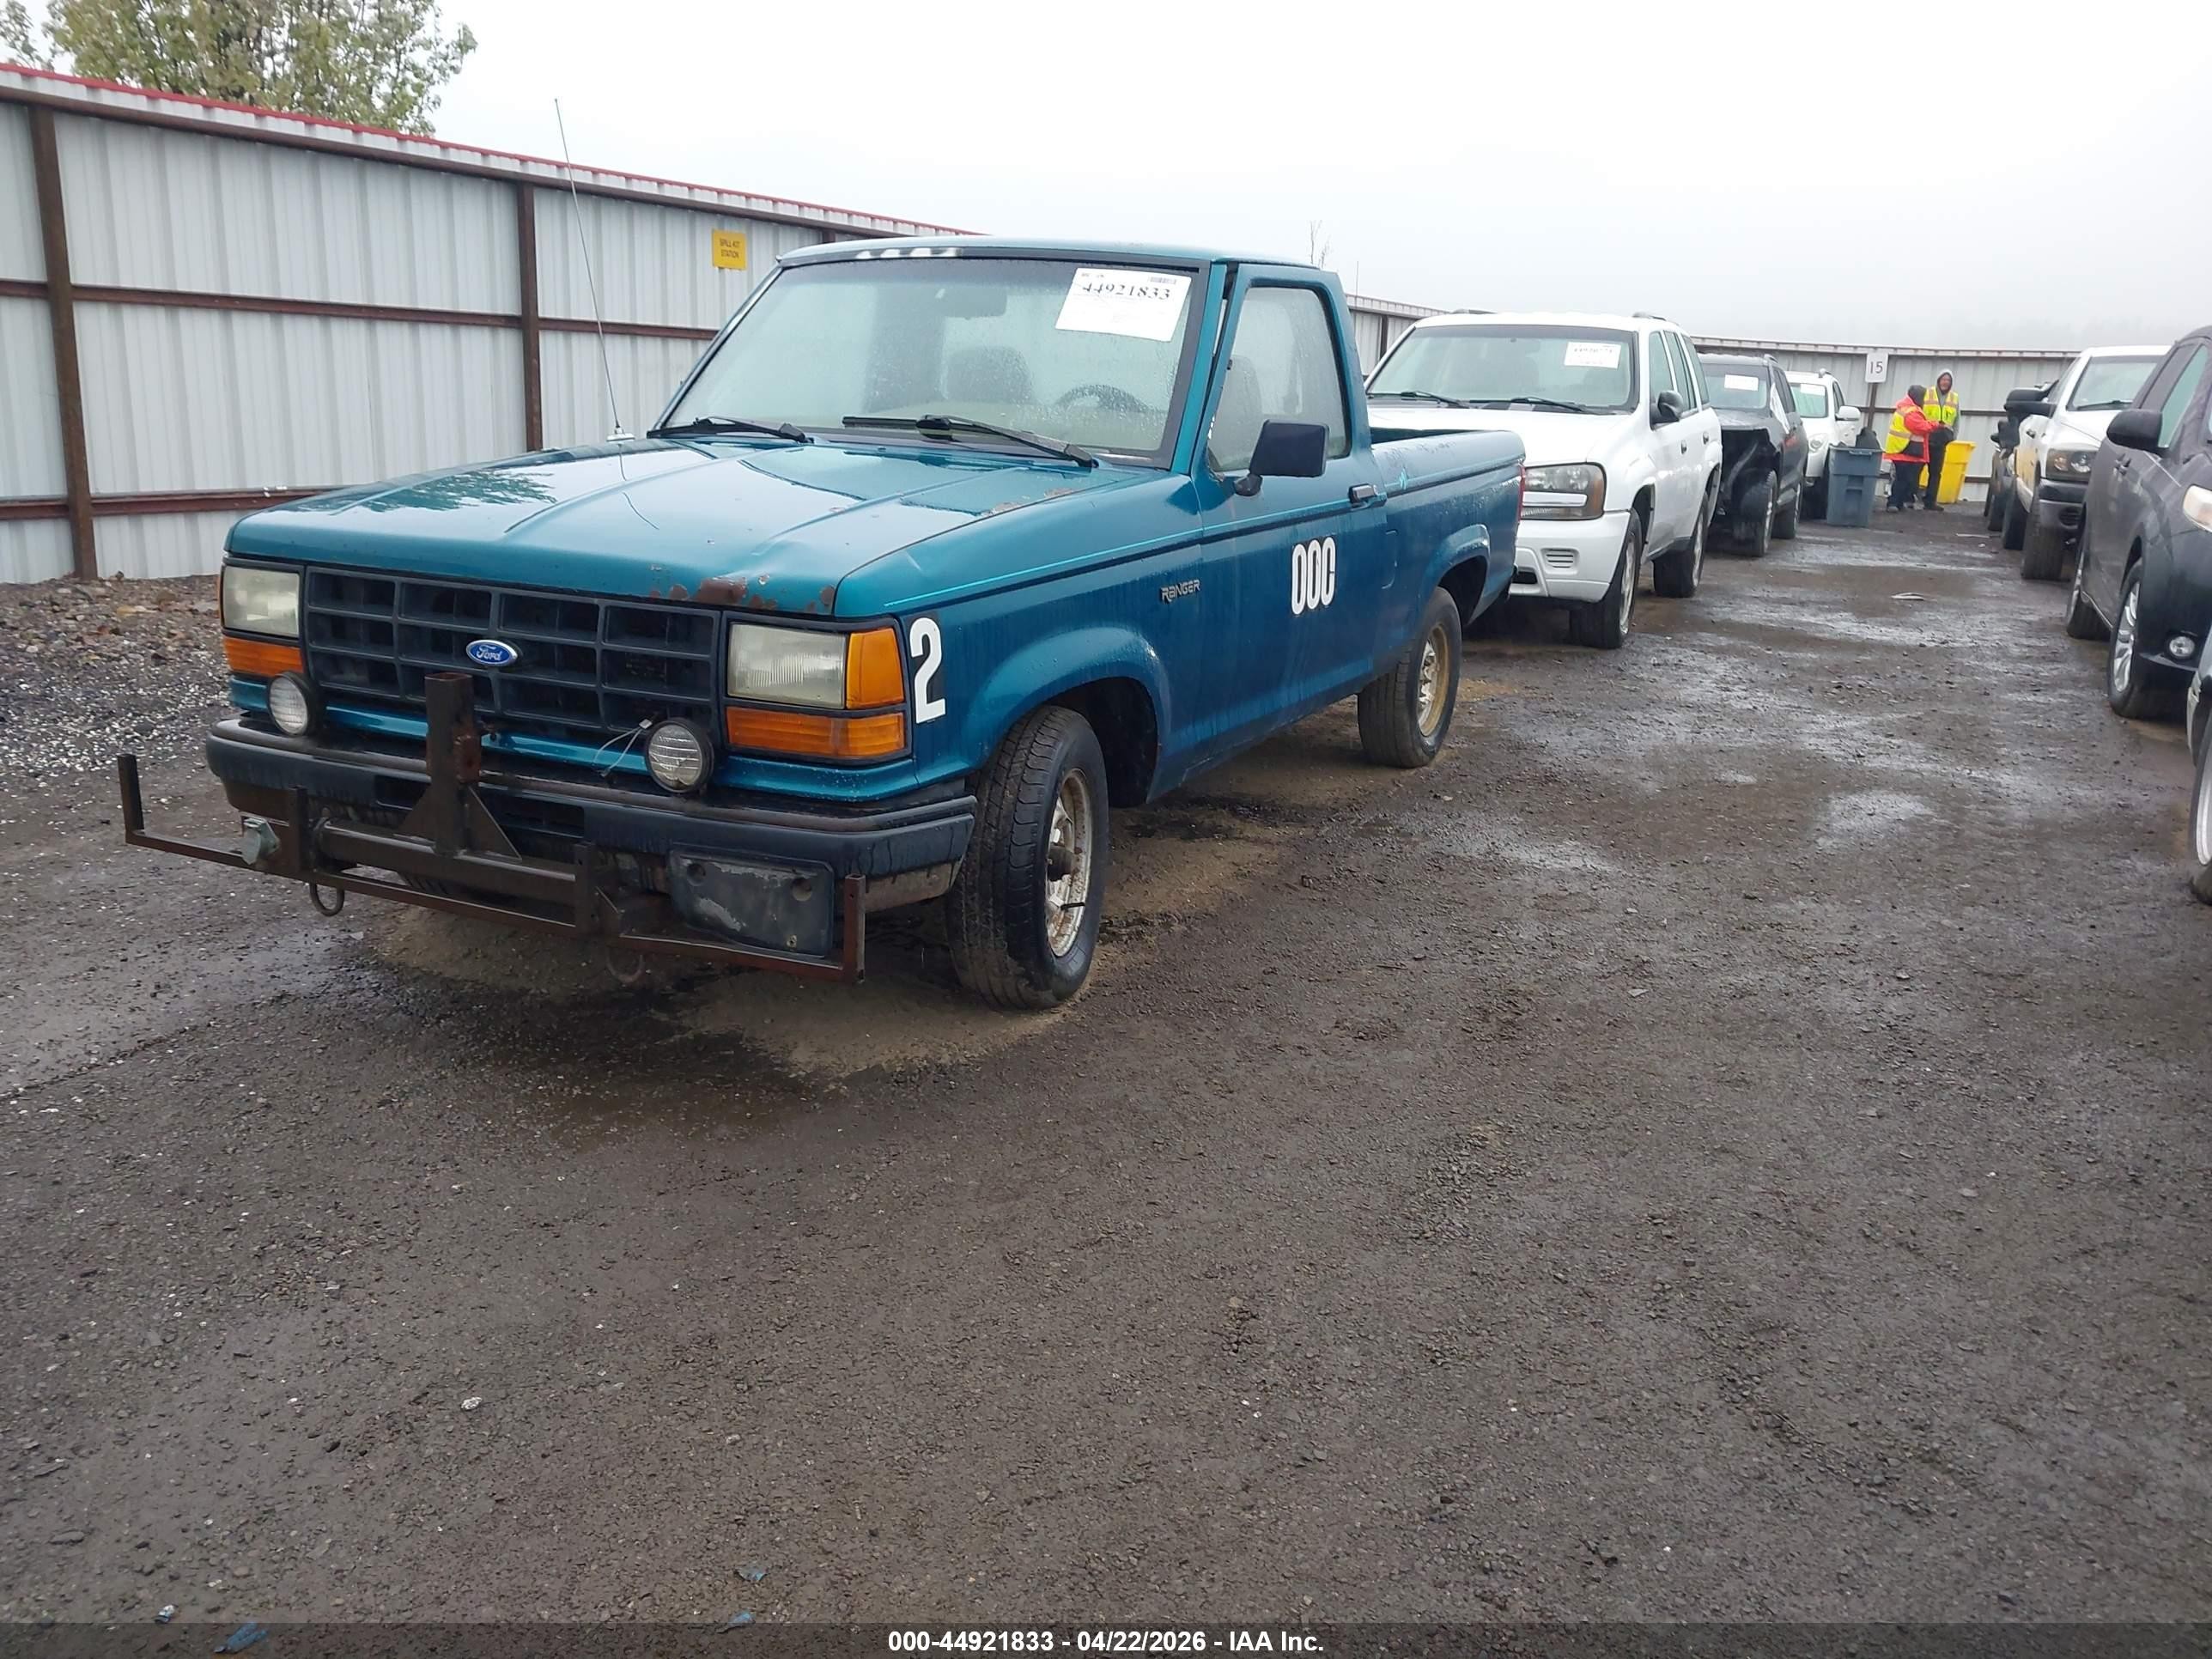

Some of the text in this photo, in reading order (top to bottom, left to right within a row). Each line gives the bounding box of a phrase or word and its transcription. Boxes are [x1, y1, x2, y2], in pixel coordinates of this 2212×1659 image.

[720, 238, 732, 247] SPILL
[721, 249, 739, 258] STATION
[1082, 283, 1171, 301] 44921833
[1870, 361, 1883, 374] 15
[1160, 578, 1201, 604] RANGER
[476, 644, 502, 661] Ford
[909, 617, 946, 724] 2
